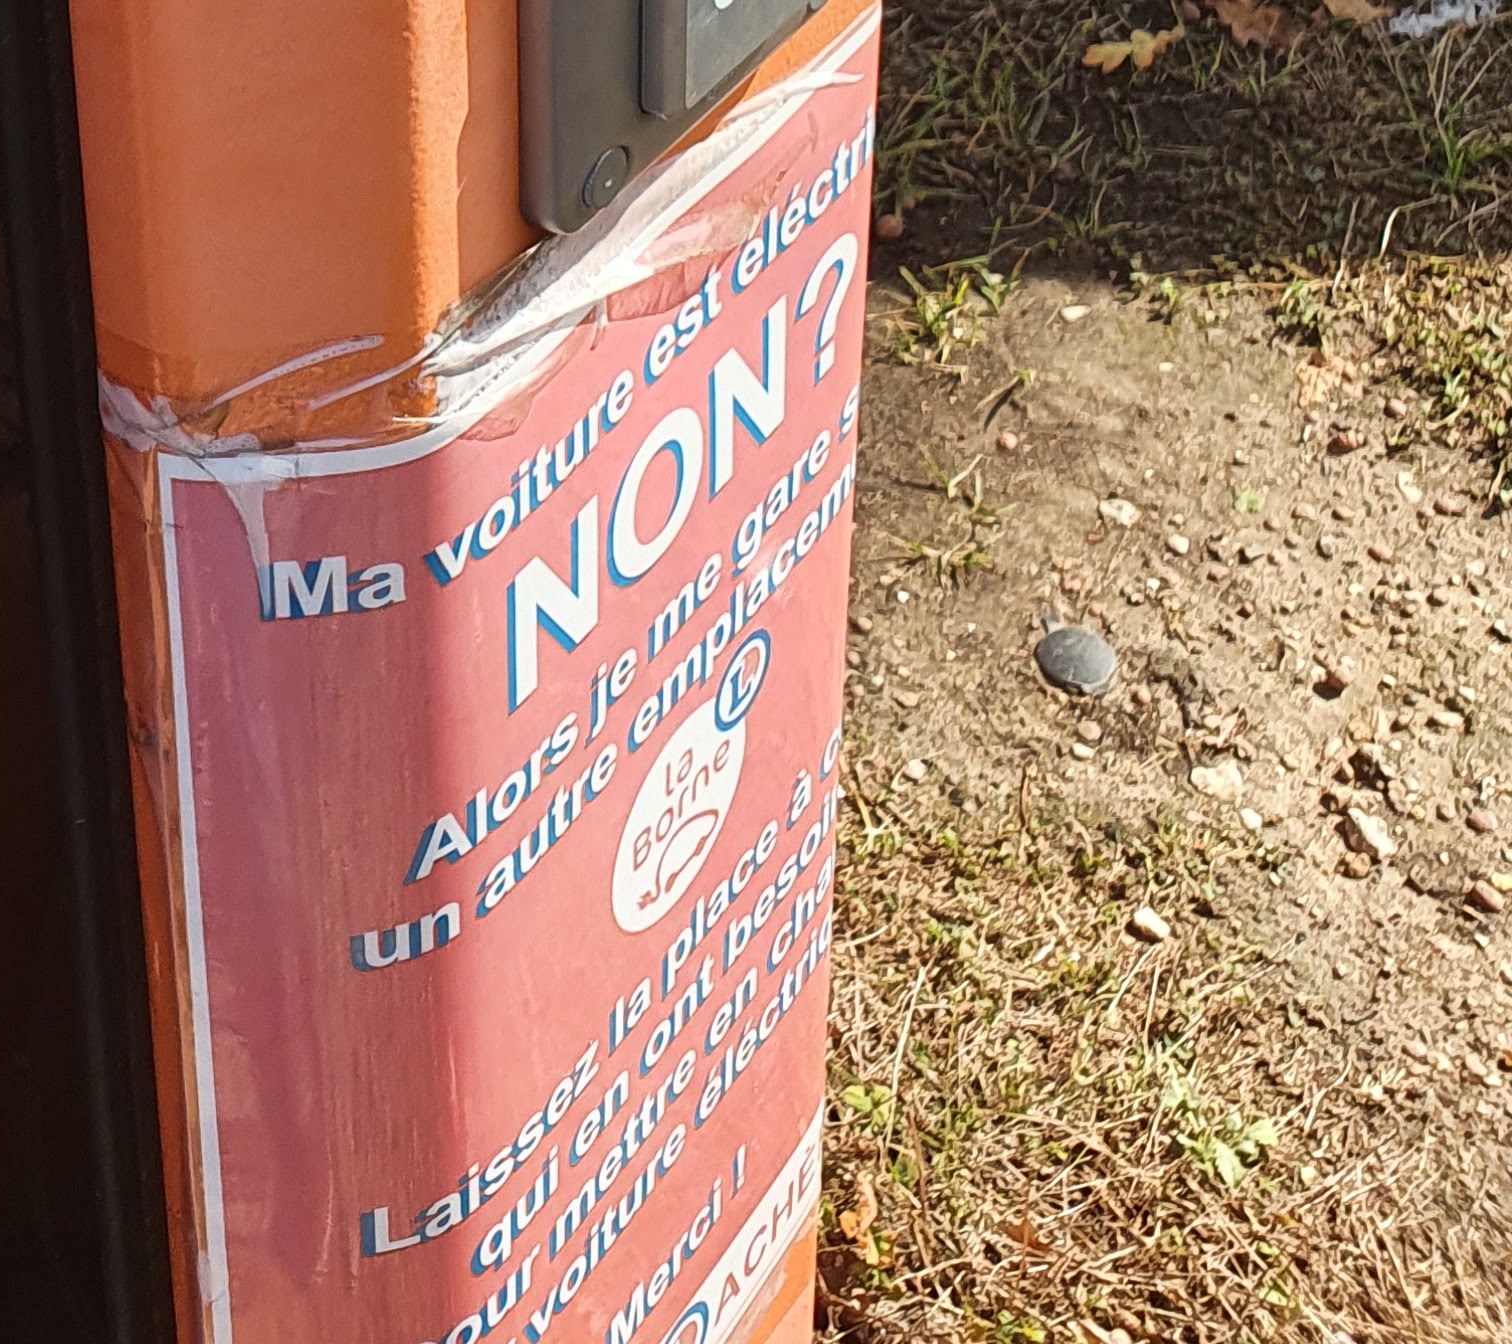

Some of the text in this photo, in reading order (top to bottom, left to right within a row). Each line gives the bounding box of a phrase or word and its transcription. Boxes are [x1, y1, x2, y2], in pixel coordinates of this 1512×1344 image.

[266, 554, 407, 620] Ma
[426, 369, 635, 587] voiture
[645, 262, 724, 385] est
[404, 710, 578, 885] Alors
[587, 649, 637, 746] je
[648, 552, 723, 662] me
[732, 428, 832, 578] gare
[665, 746, 694, 797] la
[351, 900, 461, 972] un
[475, 744, 618, 918] autre
[633, 738, 731, 872] Borne
[362, 1039, 601, 1257] Laissez
[610, 977, 652, 1053] la
[661, 819, 779, 1002] place
[786, 767, 812, 832] à
[470, 1144, 560, 1278] qui
[570, 1068, 630, 1167] en
[640, 953, 716, 1075] ont
[418, 1243, 542, 1344] our
[549, 1048, 695, 1261] mettre
[706, 968, 759, 1054] en
[524, 1122, 686, 1343] voiture
[605, 1176, 723, 1344] Merci
